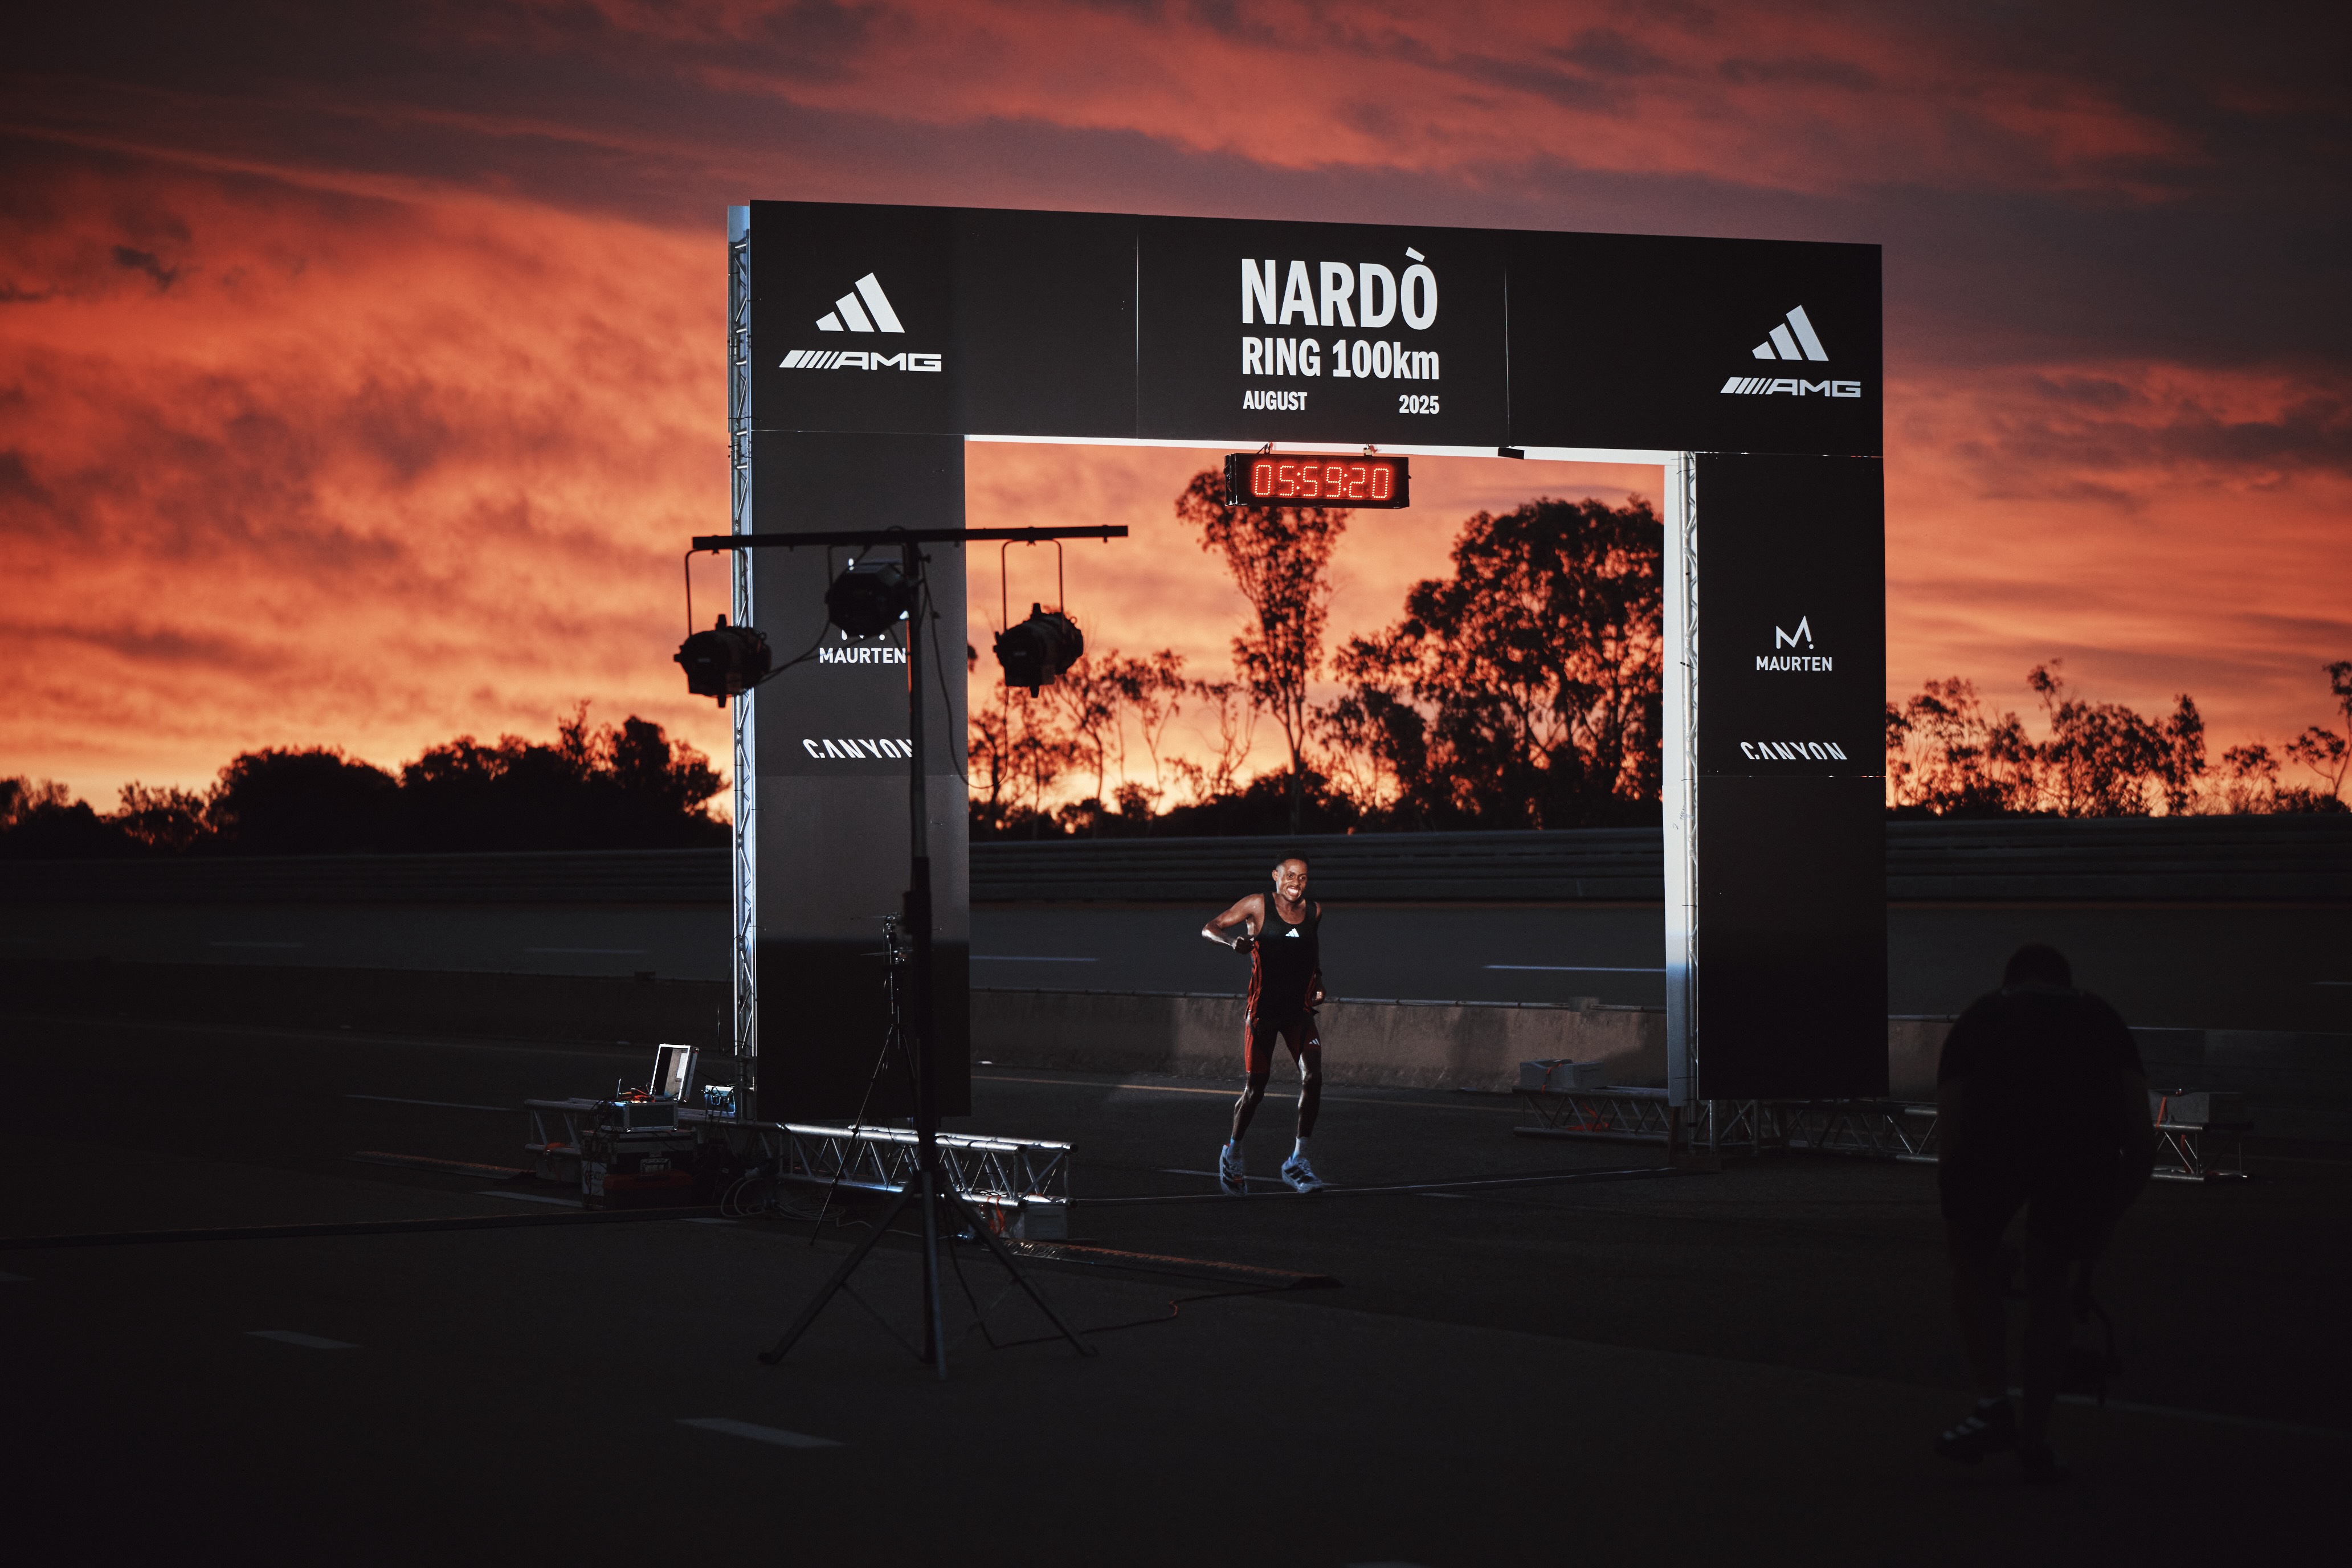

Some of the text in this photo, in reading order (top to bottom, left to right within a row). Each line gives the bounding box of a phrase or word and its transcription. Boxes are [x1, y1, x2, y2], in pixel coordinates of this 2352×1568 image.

[1242, 247, 1438, 330] NARDÒ
[830, 352, 941, 371] AMG
[1243, 337, 1439, 379] RING 100km
[1765, 379, 1860, 397] AMG
[1243, 390, 1439, 414] AUGUST 2025
[1254, 464, 1389, 499] 05:59:20
[820, 648, 906, 663] MAURTEN
[1757, 656, 1832, 671] MAURTEN
[1741, 742, 1847, 760] CANYON
